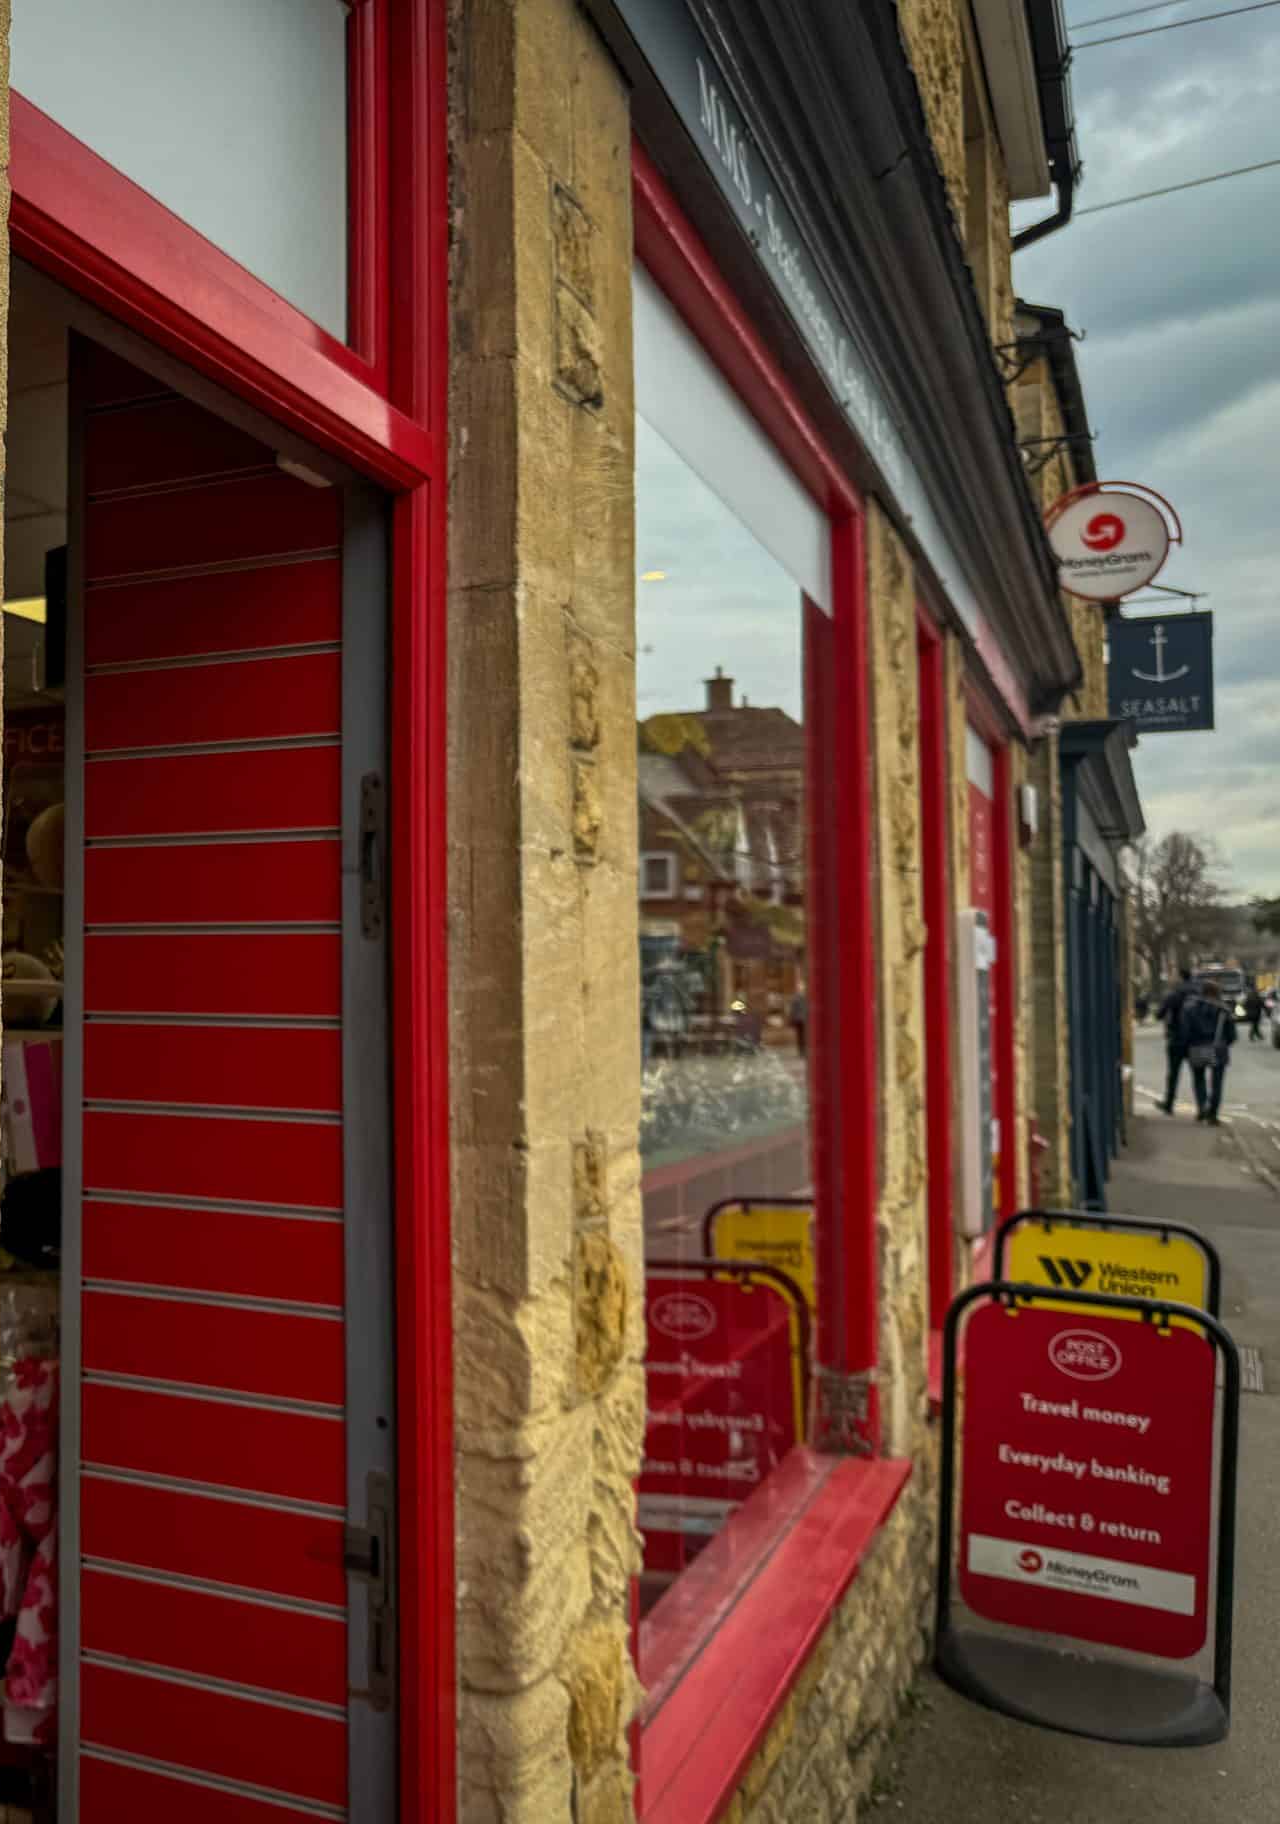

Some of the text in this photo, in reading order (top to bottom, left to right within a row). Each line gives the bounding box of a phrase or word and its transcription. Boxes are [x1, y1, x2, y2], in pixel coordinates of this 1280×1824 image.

[1120, 697, 1200, 719] SEASALT
[1099, 1260, 1180, 1286] Western
[1098, 1279, 1156, 1297] Union
[1056, 1350, 1111, 1370] OFFICE
[1066, 1339, 1107, 1355] POST
[1020, 1391, 1151, 1434] Travel money
[998, 1443, 1171, 1494] Everyday banking
[1004, 1499, 1162, 1544] Collect & return
[1047, 1560, 1139, 1590] MoneyGram
